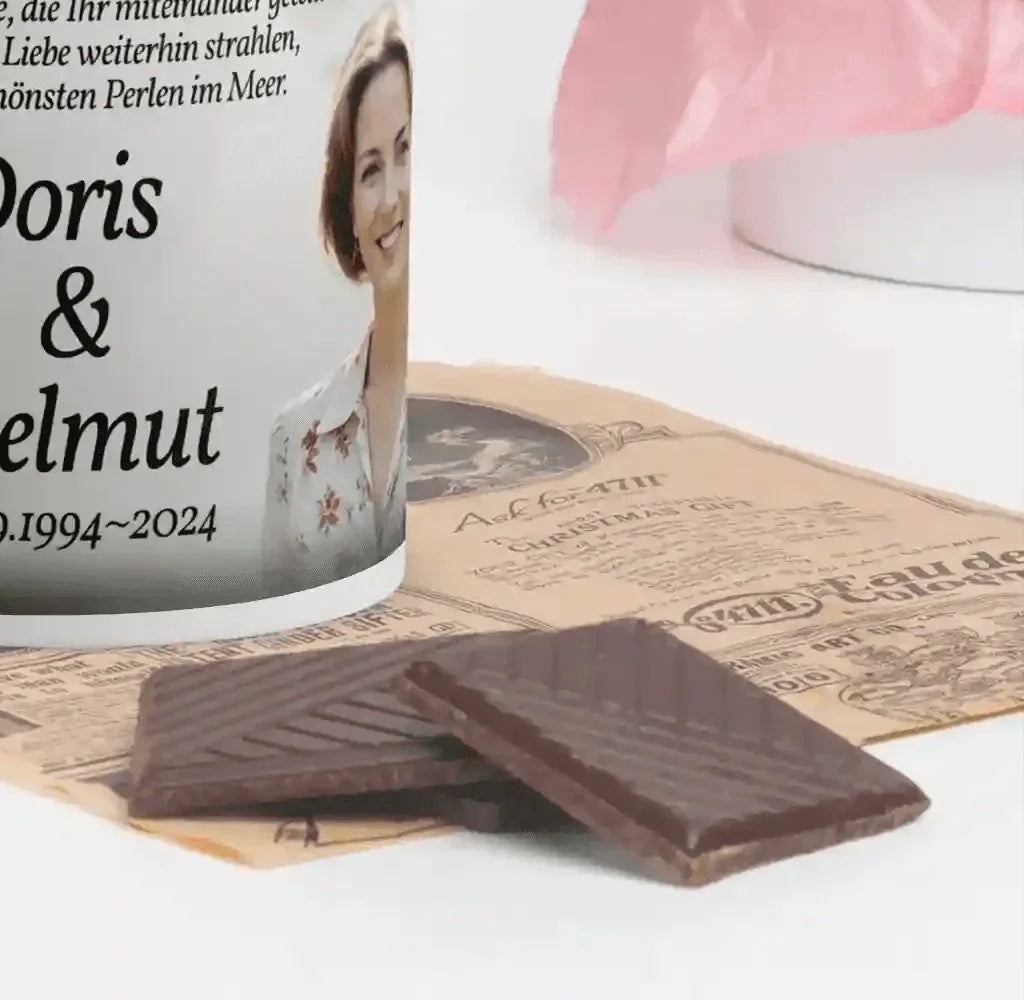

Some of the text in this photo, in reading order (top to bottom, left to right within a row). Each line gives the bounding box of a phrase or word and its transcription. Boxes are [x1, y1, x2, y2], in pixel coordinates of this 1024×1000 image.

[1, 34, 72, 67] Liebe
[76, 31, 200, 67] weiterhin
[203, 23, 302, 57] strahlen,
[103, 75, 185, 111] Perlen
[189, 73, 223, 106] im
[226, 69, 289, 103] Meer.
[40, 266, 112, 359] &
